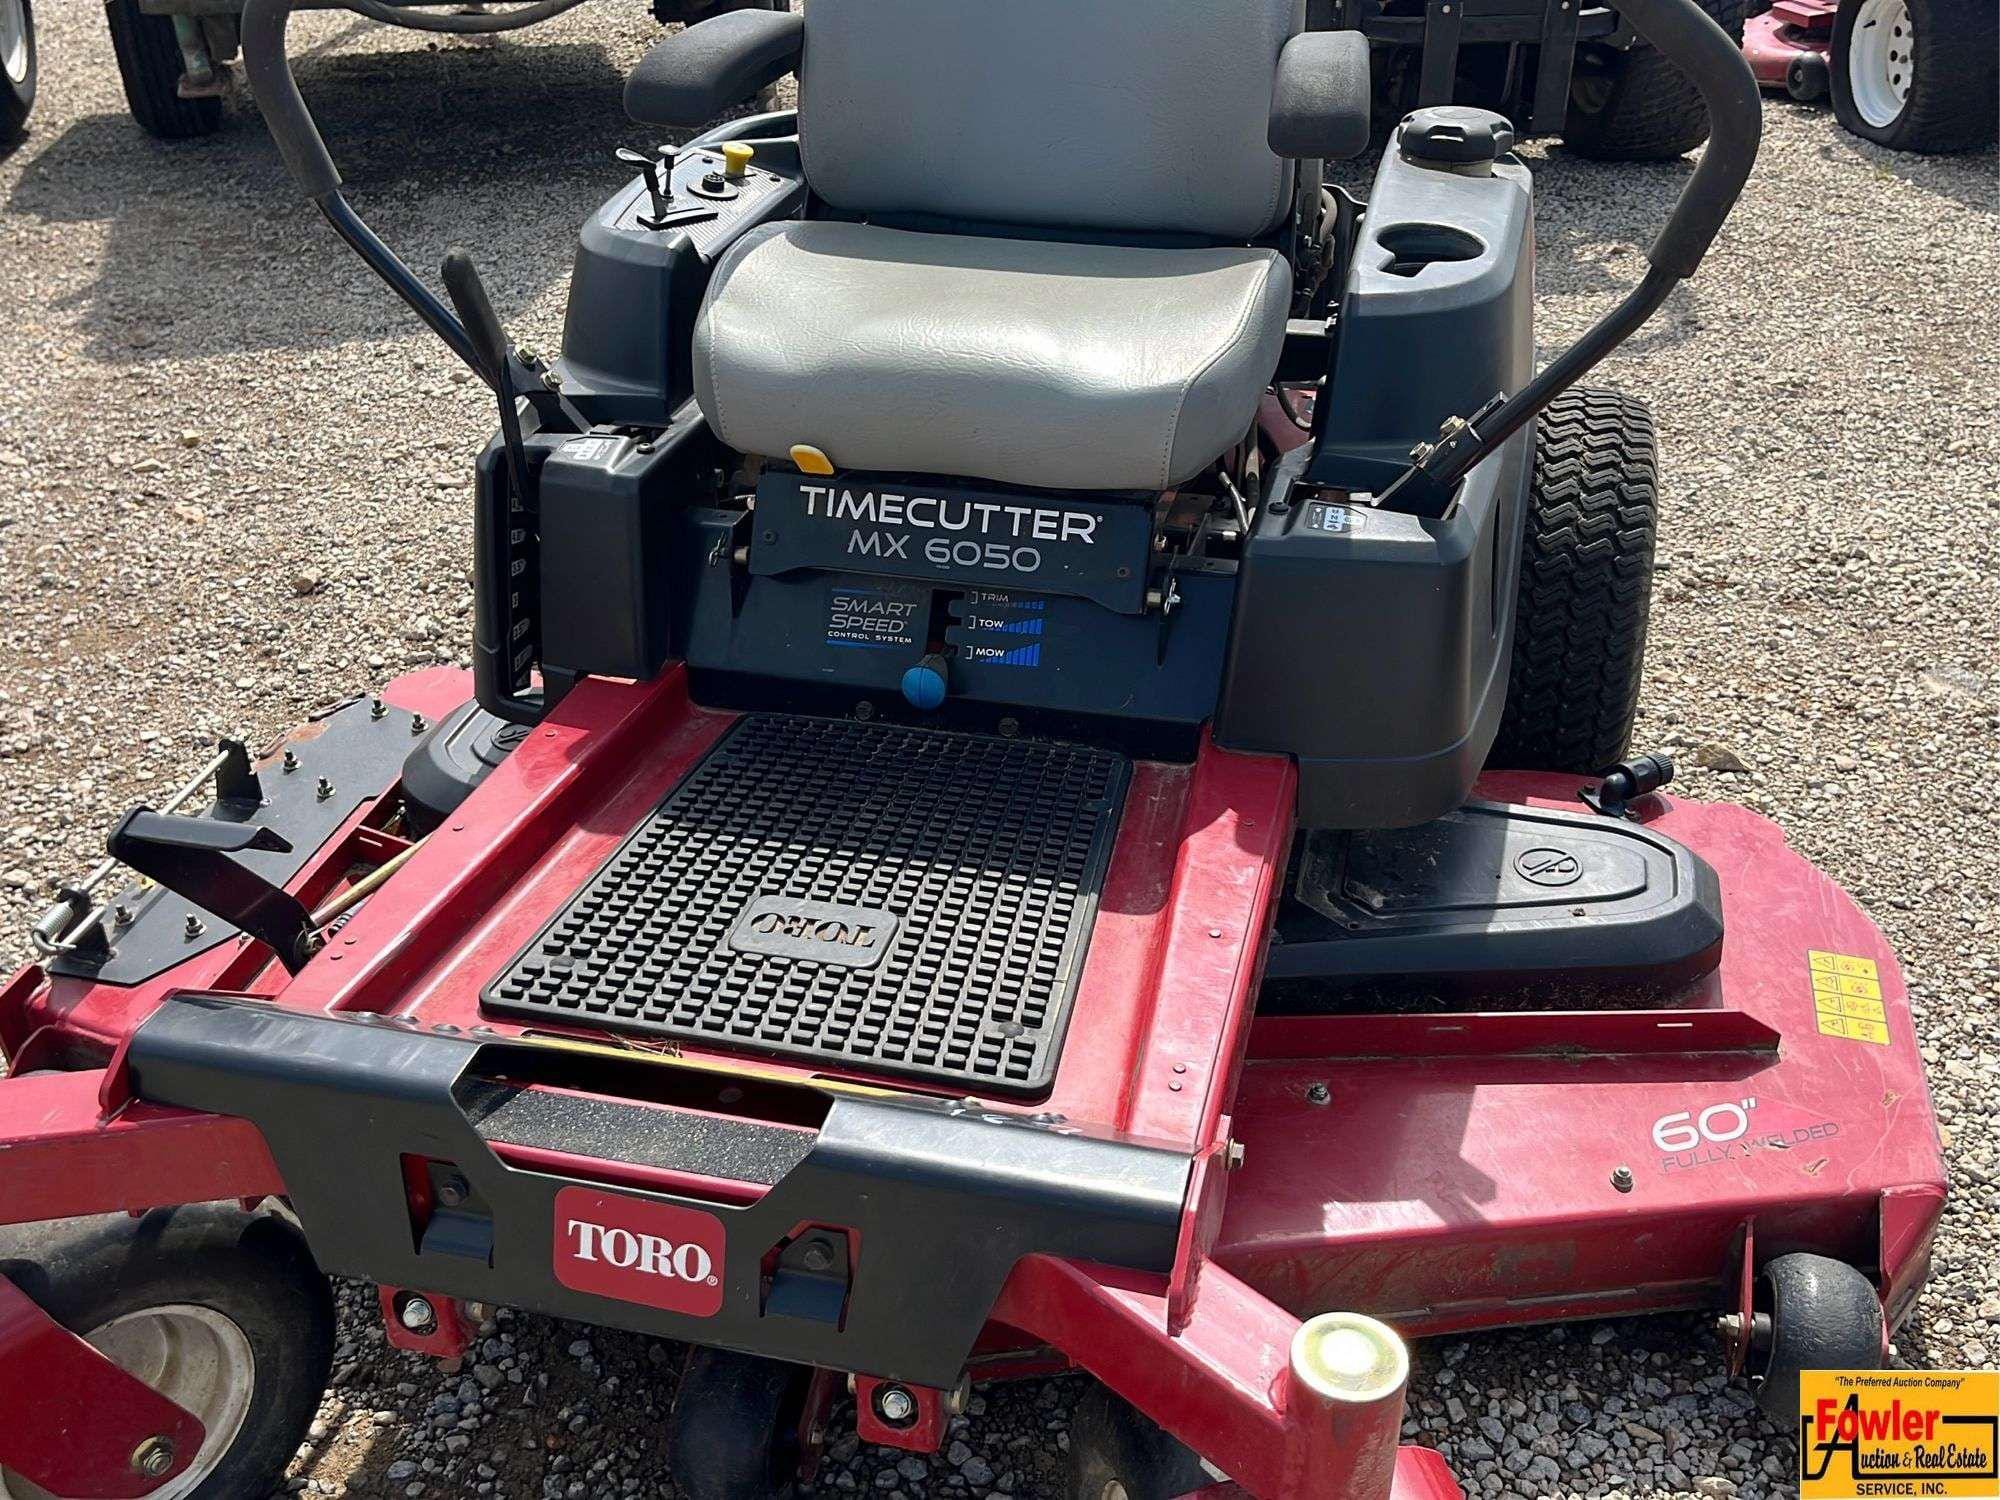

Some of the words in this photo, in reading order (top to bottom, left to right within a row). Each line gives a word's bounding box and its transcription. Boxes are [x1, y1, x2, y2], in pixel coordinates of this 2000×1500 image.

[847, 529, 911, 560] MX
[925, 538, 1041, 573] 6050
[981, 592, 1009, 602] TRIM
[831, 596, 917, 617] SMART
[979, 618, 1004, 628] TOW
[827, 630, 870, 640] CONTROL
[875, 634, 912, 643] SYSTEM
[975, 647, 1005, 657] MOW
[751, 912, 876, 948] TORO
[1662, 1146, 1733, 1173] FULLY
